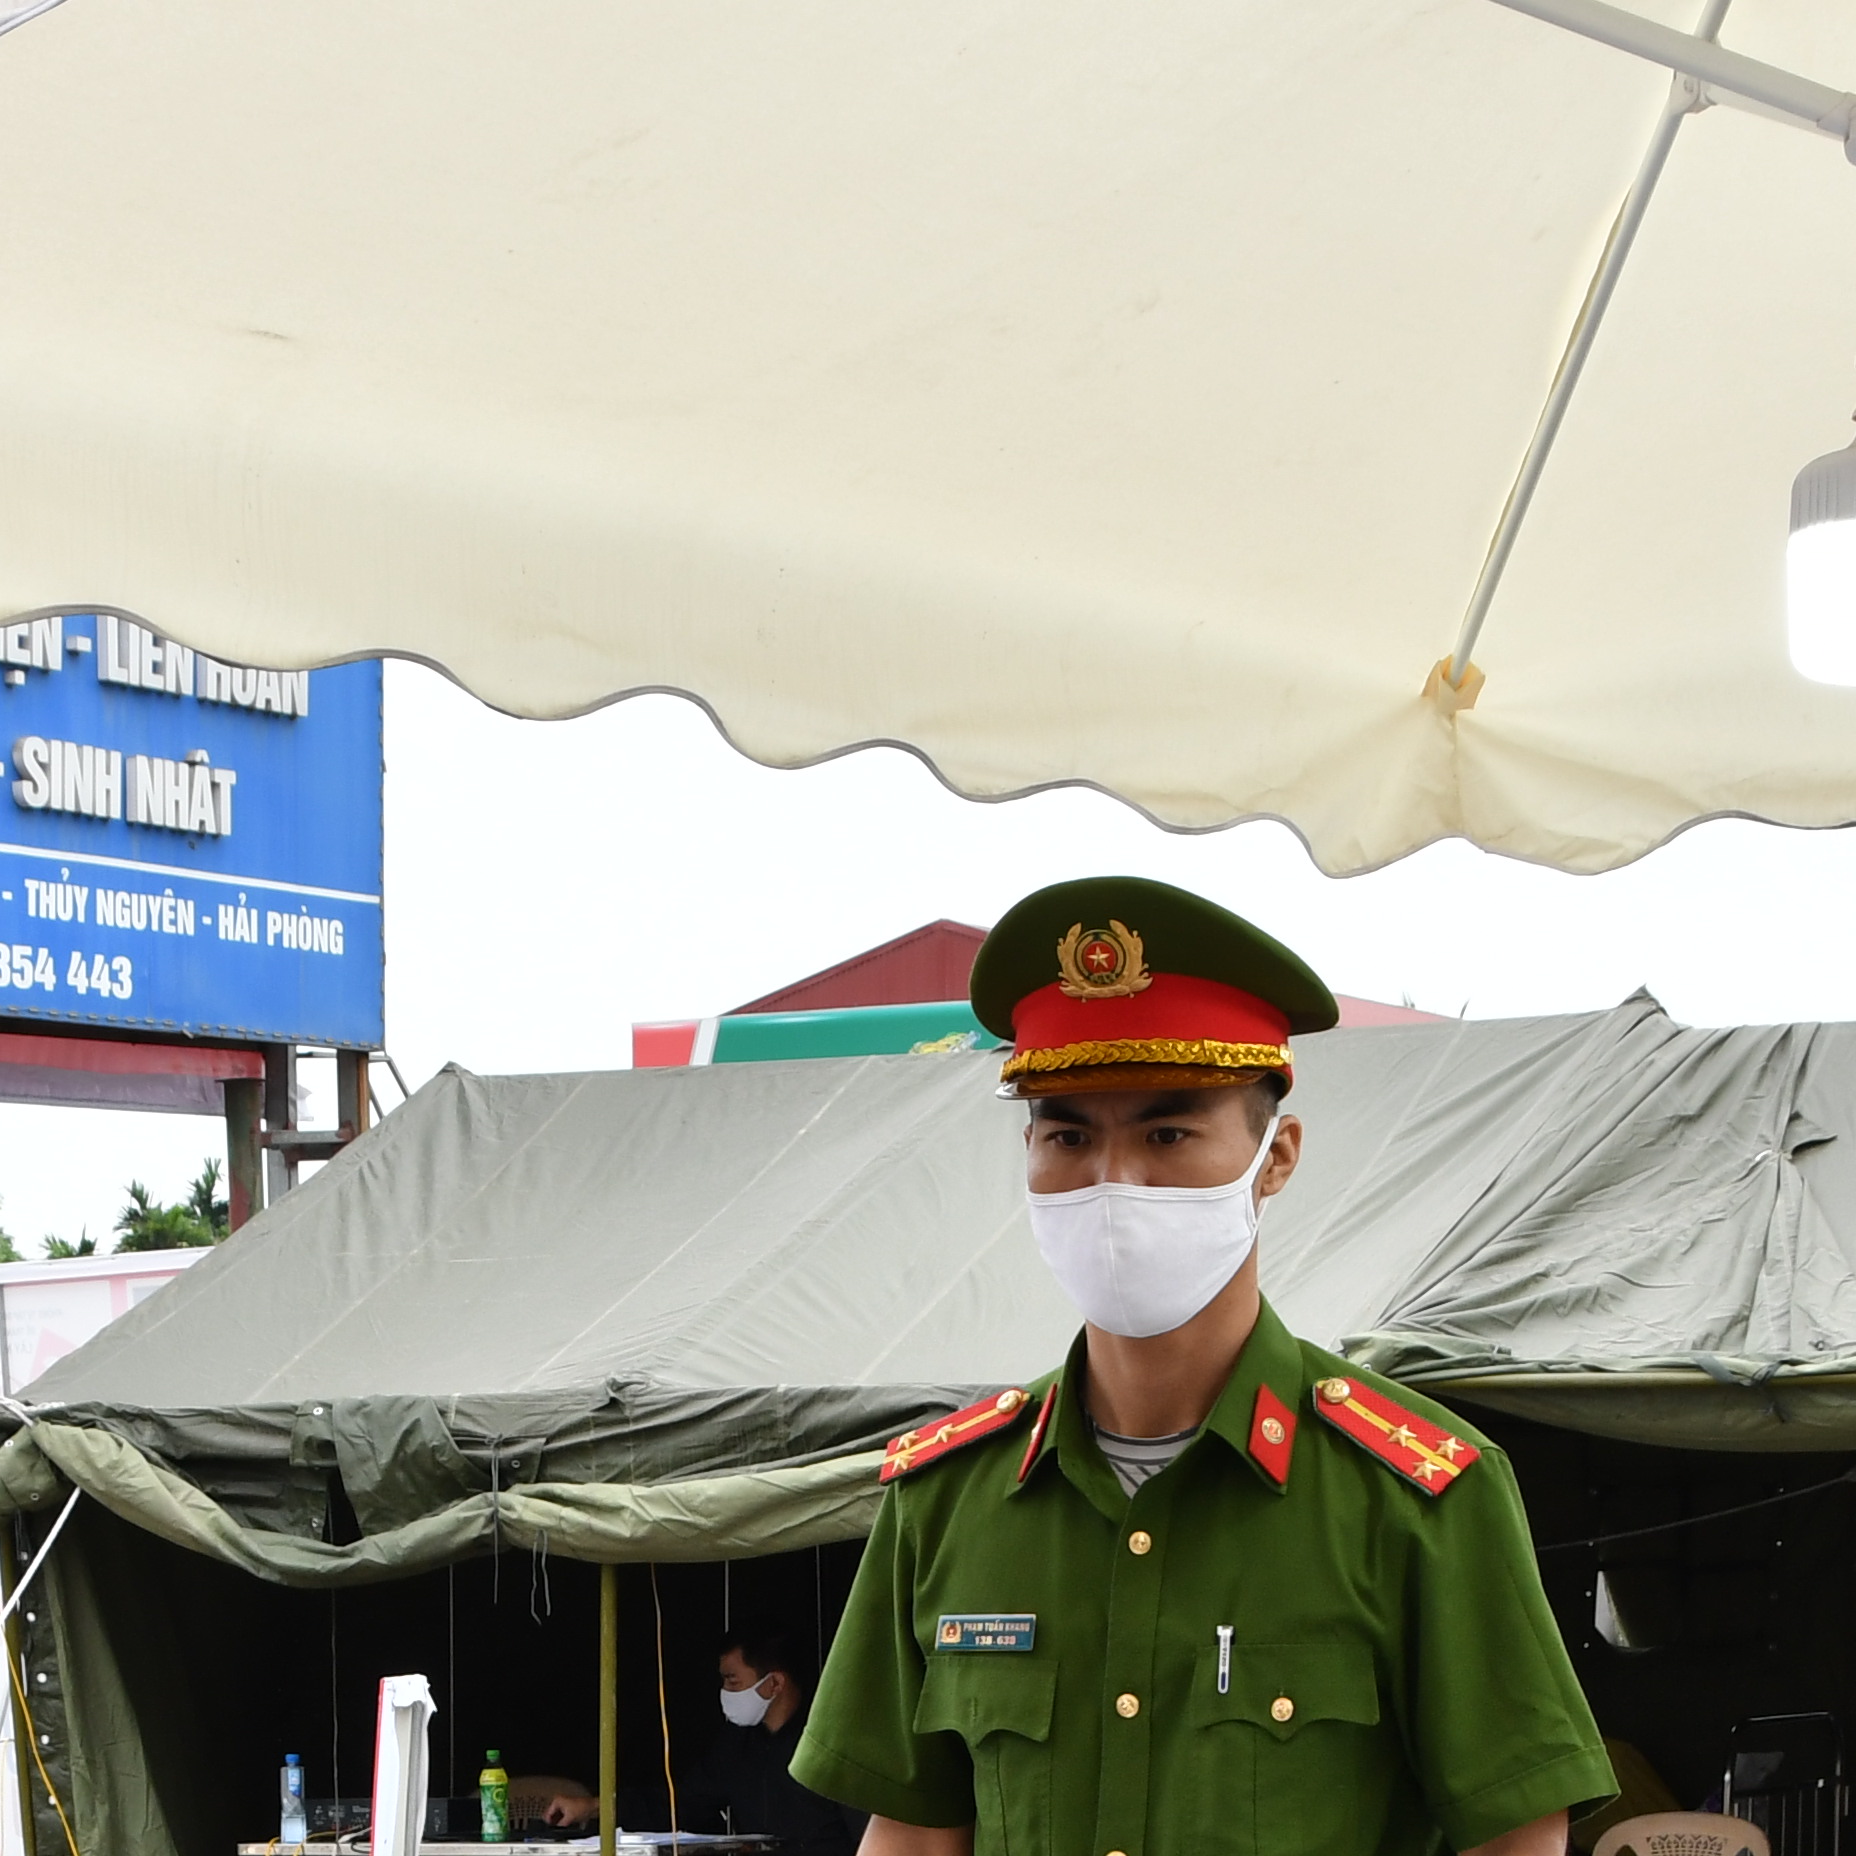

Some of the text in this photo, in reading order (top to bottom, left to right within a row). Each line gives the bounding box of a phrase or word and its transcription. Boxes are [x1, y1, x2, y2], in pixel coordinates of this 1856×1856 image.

[11, 735, 122, 820] SINH
[25, 867, 89, 924] THỦY
[95, 888, 195, 936] NGUYÊN
[218, 892, 259, 944] HẢI
[267, 905, 344, 955] PHÒNG
[67, 950, 133, 1000] 443
